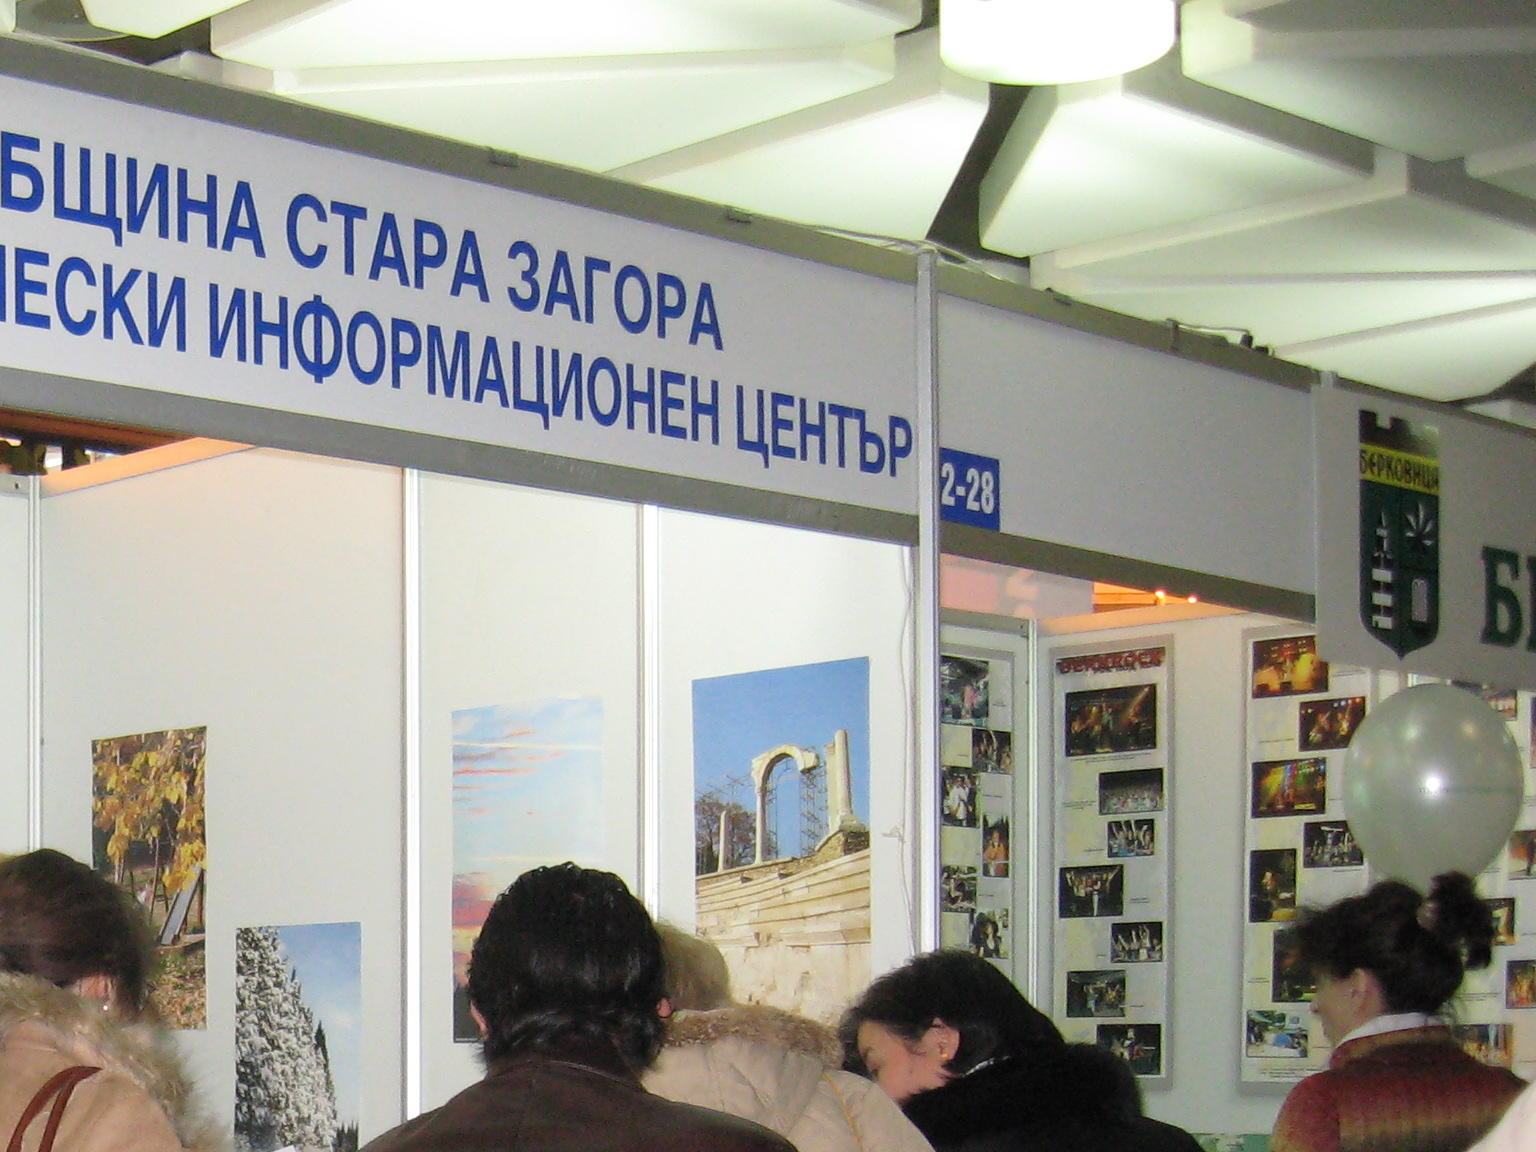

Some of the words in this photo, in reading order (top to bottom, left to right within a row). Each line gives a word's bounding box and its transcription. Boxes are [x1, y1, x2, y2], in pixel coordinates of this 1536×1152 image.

[286, 193, 489, 302] СТАРА
[506, 240, 724, 350] ЗАГОРА
[209, 283, 719, 445] ИНФОРМАЦИОНЕН
[736, 385, 912, 477] ЦЕНТЪР
[941, 462, 994, 514] 2-28
